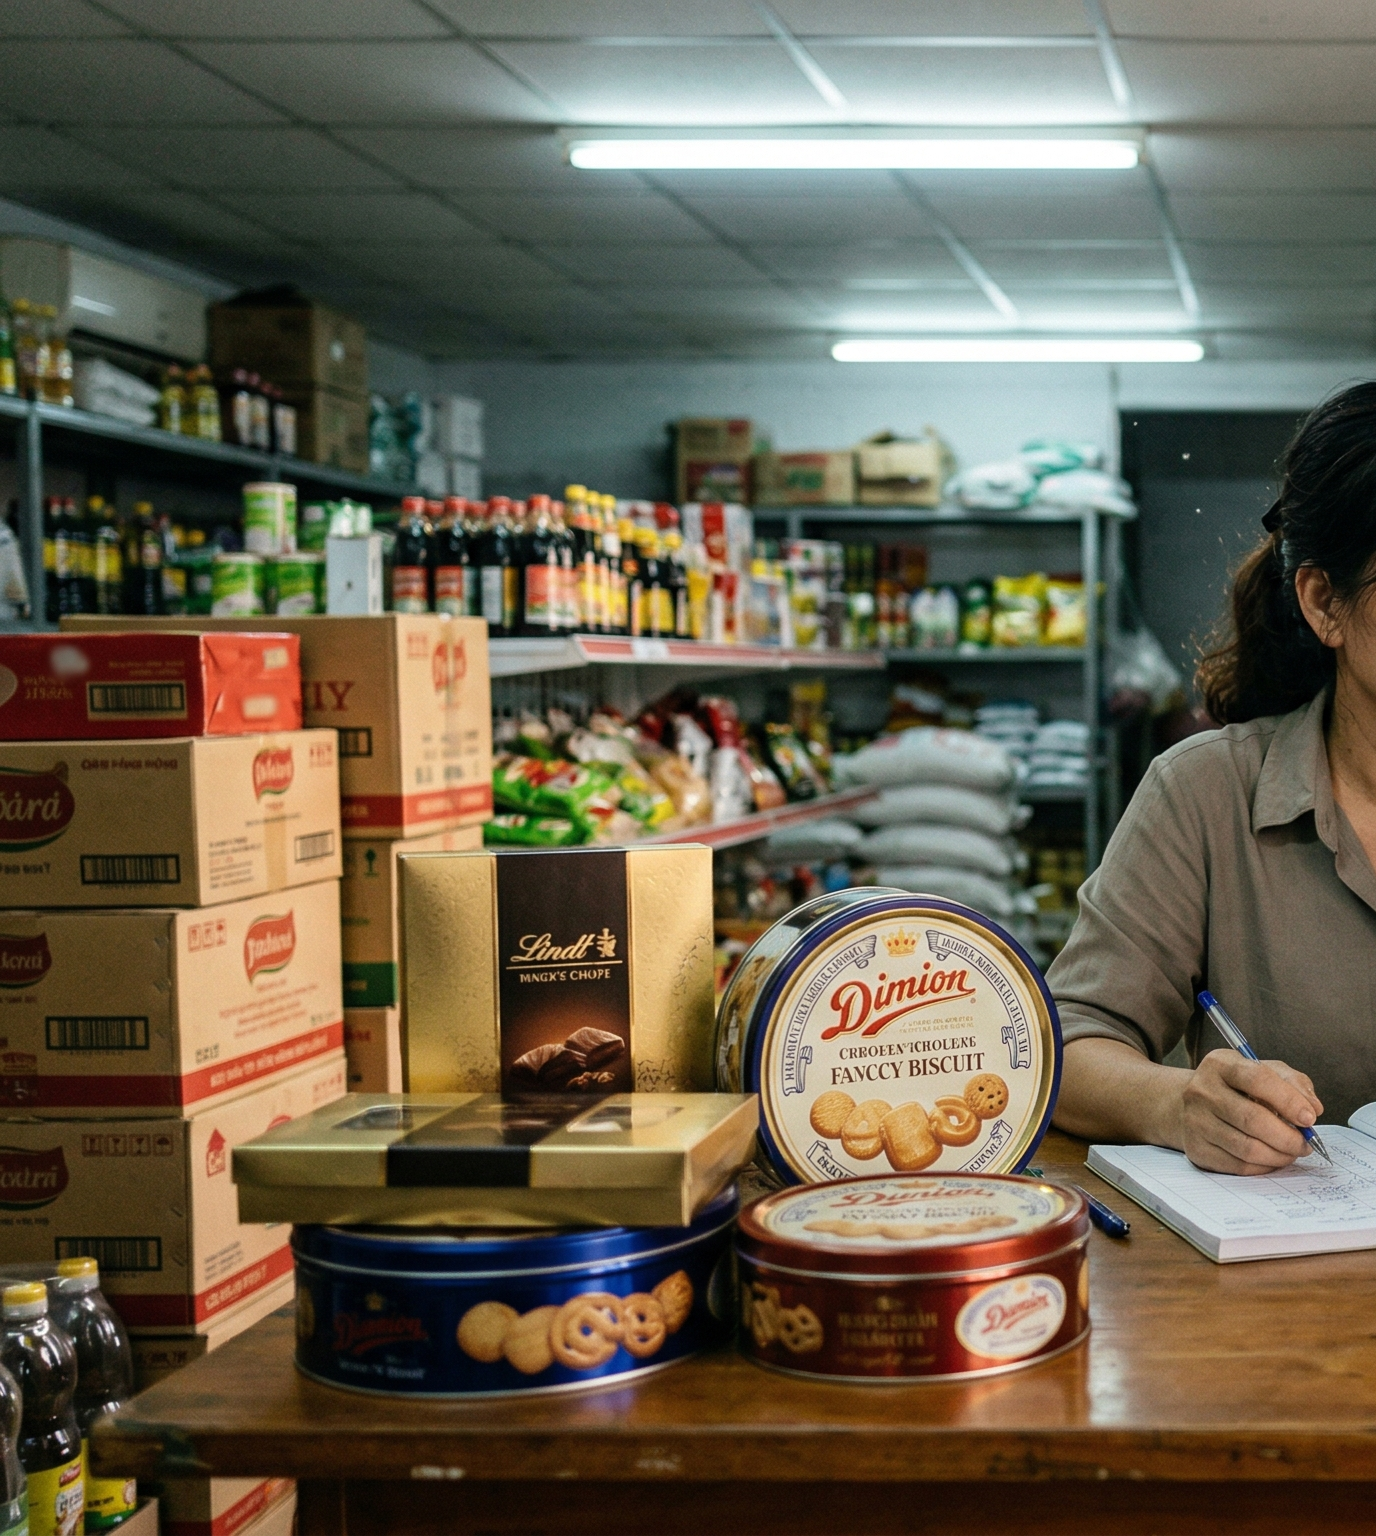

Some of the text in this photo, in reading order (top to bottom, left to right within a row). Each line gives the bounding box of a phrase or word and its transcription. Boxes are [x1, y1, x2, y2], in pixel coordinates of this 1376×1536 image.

[510, 933, 596, 962] Lindt
[822, 962, 977, 1041] Dimion
[831, 1052, 985, 1085] FANCCY BISCUIT
